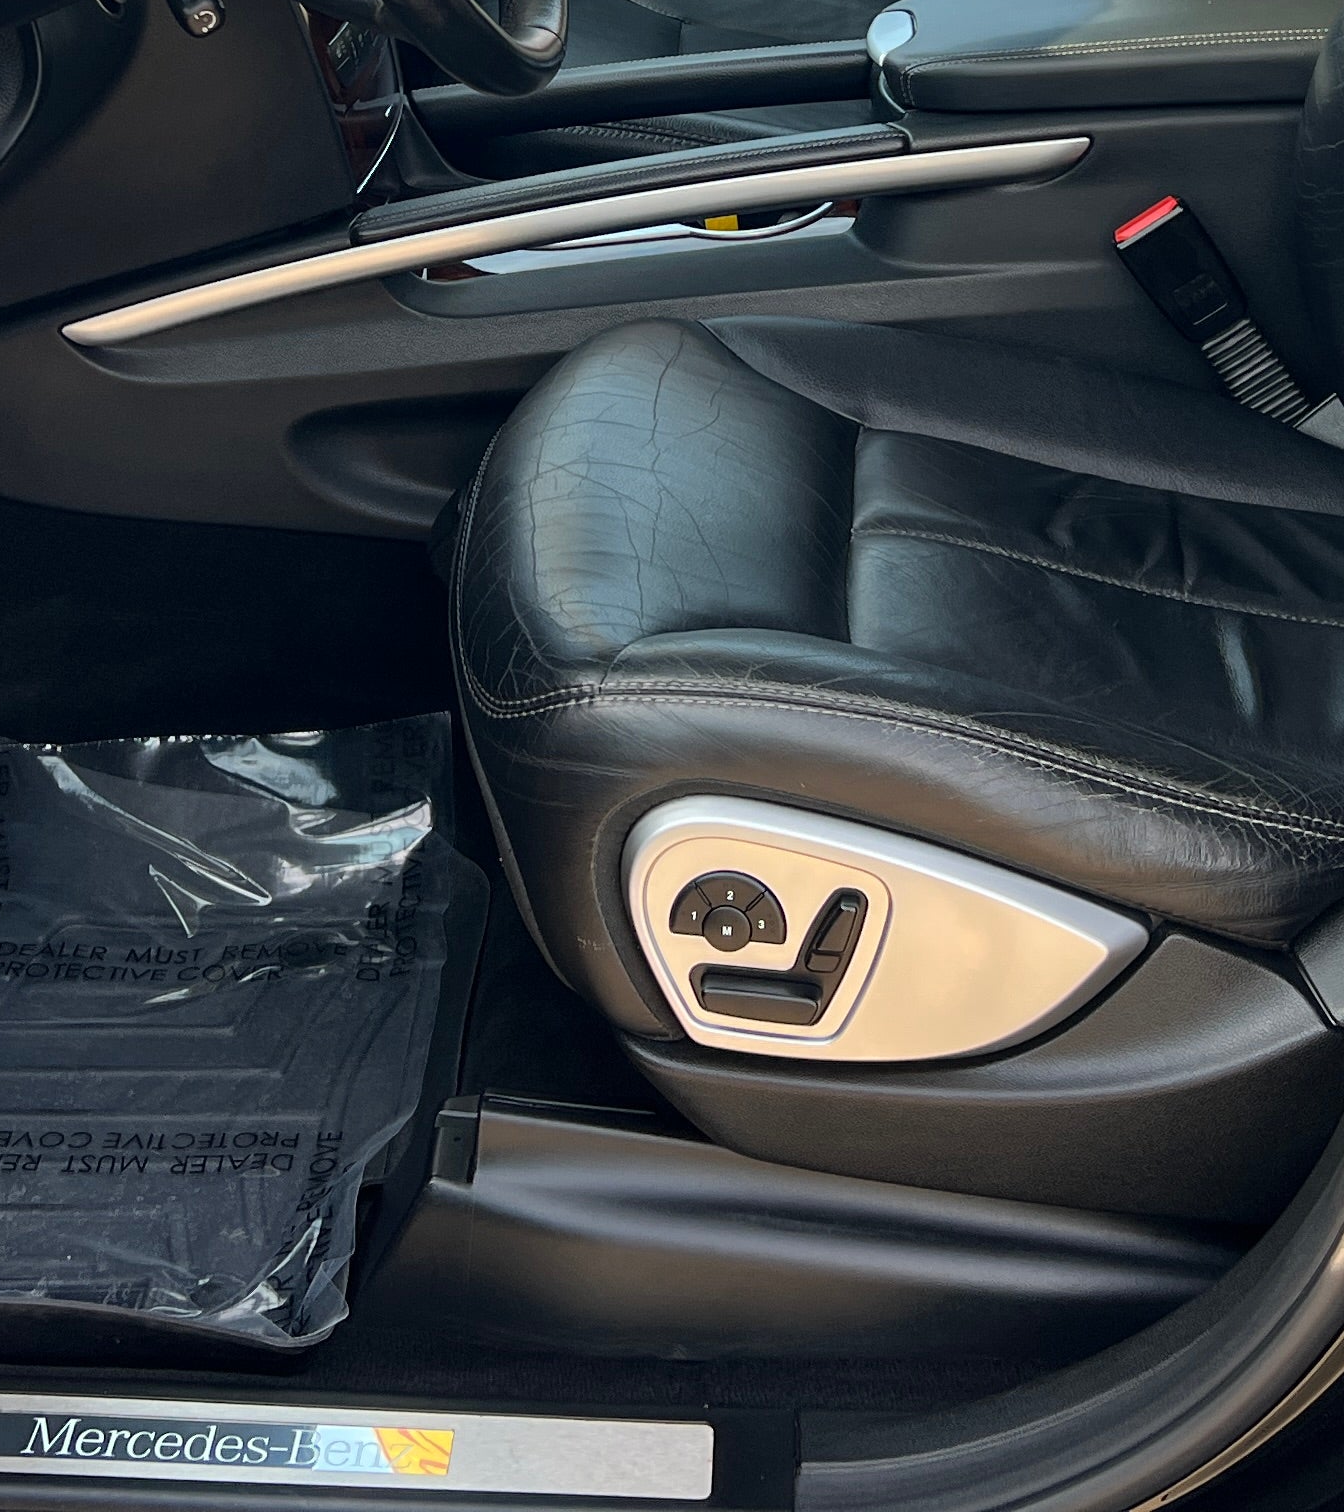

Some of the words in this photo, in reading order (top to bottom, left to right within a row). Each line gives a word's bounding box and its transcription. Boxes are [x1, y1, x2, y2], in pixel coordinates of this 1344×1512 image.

[726, 890, 734, 901] 2
[691, 911, 697, 921] 1
[758, 919, 765, 929] 3
[721, 926, 733, 936] M
[125, 944, 204, 966] MUST
[221, 938, 349, 961] REMOVE
[102, 1131, 301, 1150] PROTECTIVE
[61, 1154, 149, 1175] MUST
[170, 1152, 295, 1174] DEALER
[20, 1415, 414, 1471] Mercedes-Benz
